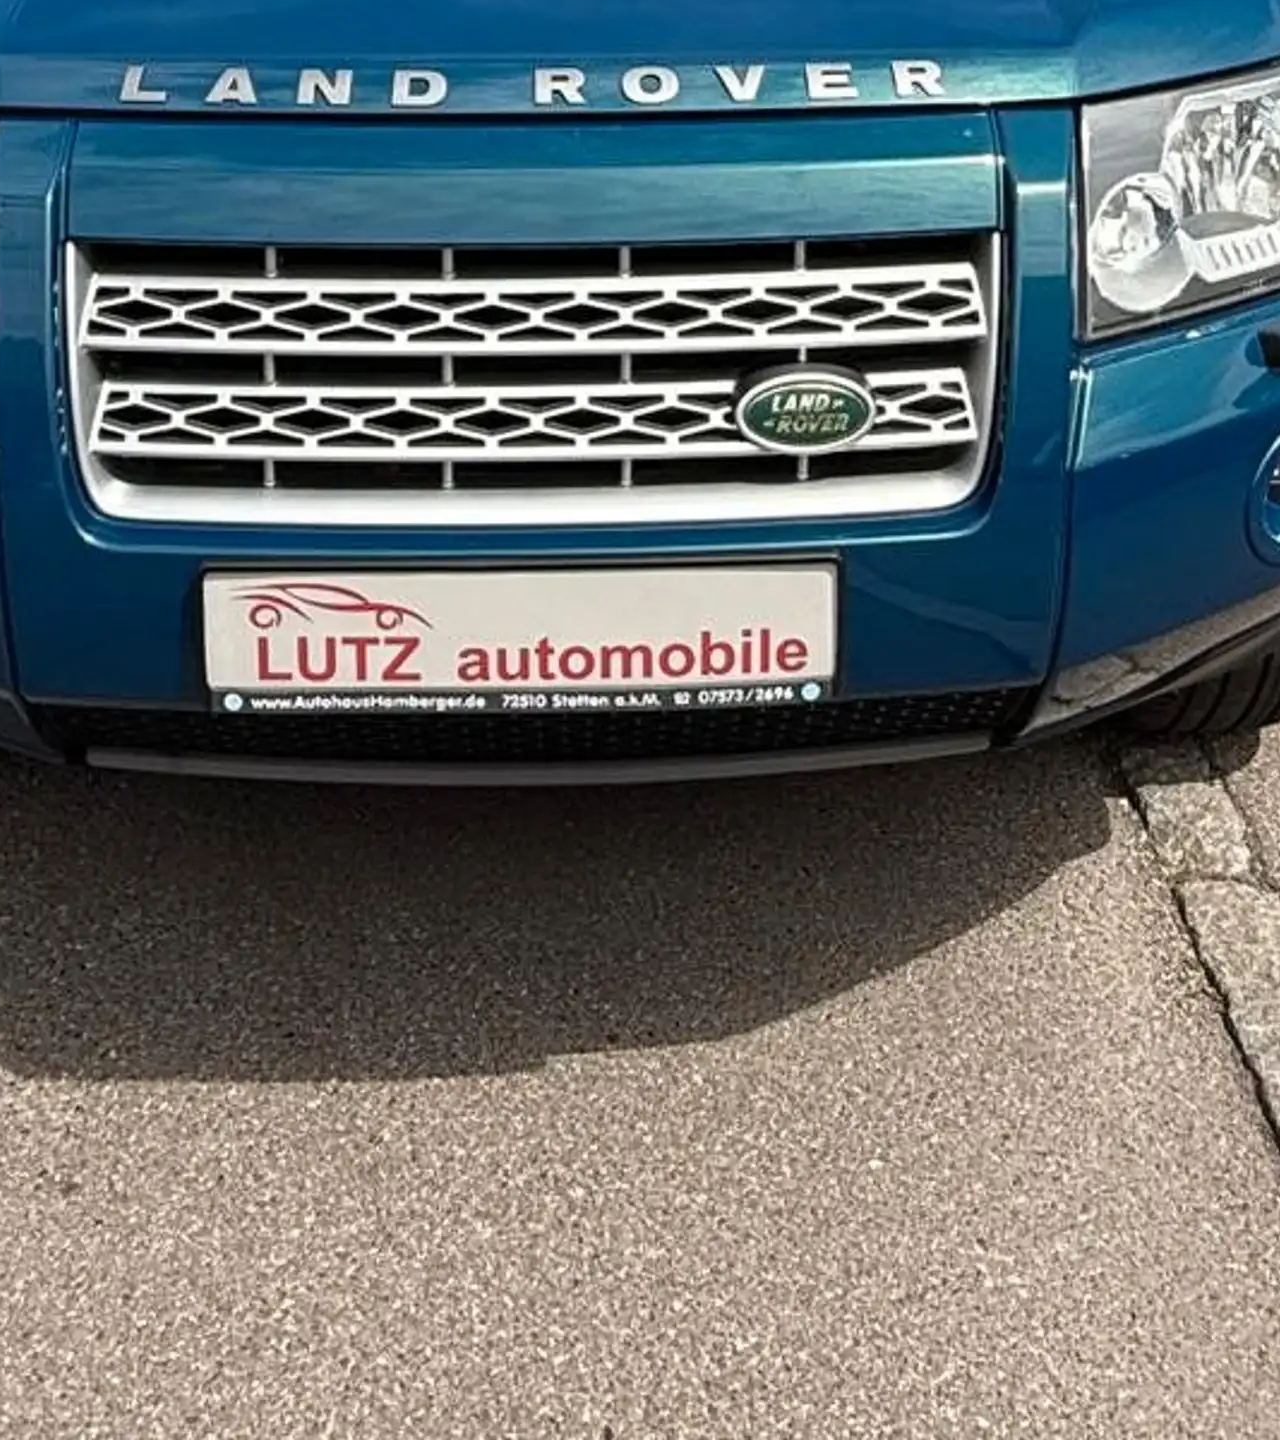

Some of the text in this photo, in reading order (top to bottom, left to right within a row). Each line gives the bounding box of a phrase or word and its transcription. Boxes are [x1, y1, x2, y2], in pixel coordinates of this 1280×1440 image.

[120, 59, 947, 107] LAND ROVER
[772, 393, 830, 412] LAND
[776, 413, 850, 432] ROVER
[258, 628, 809, 681] LUTZ automobile
[502, 693, 546, 709] 72510
[552, 693, 609, 708] Stetten
